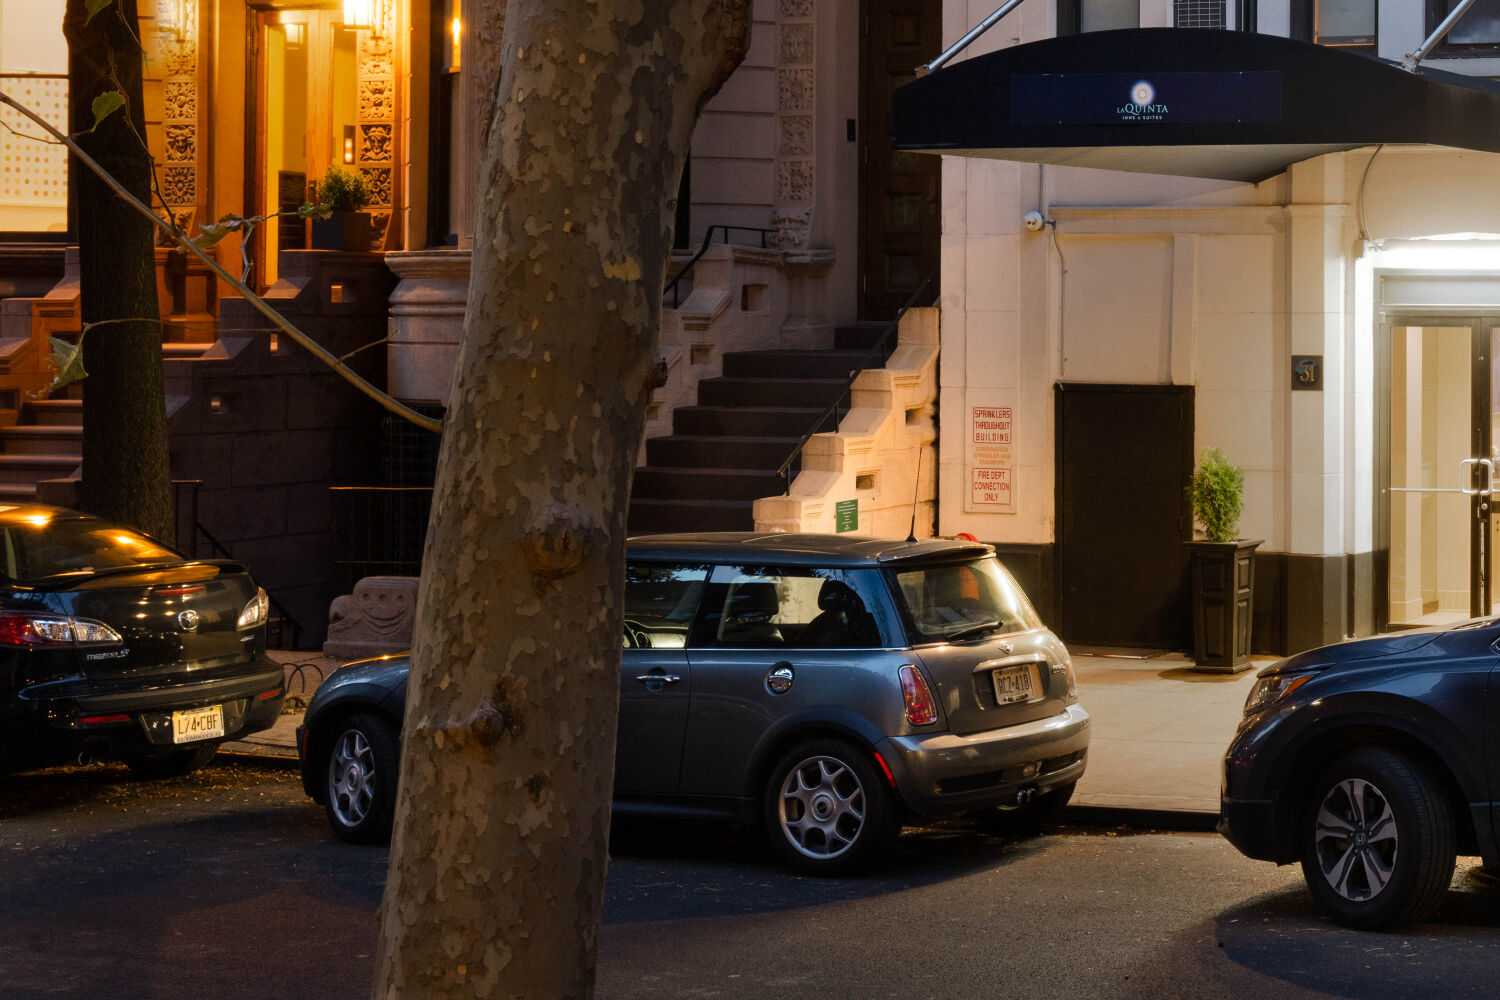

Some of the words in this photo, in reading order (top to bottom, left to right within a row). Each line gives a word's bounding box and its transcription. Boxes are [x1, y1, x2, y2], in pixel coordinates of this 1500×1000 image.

[1125, 103, 1168, 116] QUINTA
[1300, 364, 1315, 382] 31
[974, 409, 1011, 419] SPRINKLERS
[975, 421, 1010, 430] THROUGHOUT
[975, 433, 1009, 441] BUILDING
[977, 471, 990, 479] FIRE
[991, 471, 1005, 479] DEPT
[974, 482, 1009, 491] CONNECTION
[984, 493, 999, 501] ONLY
